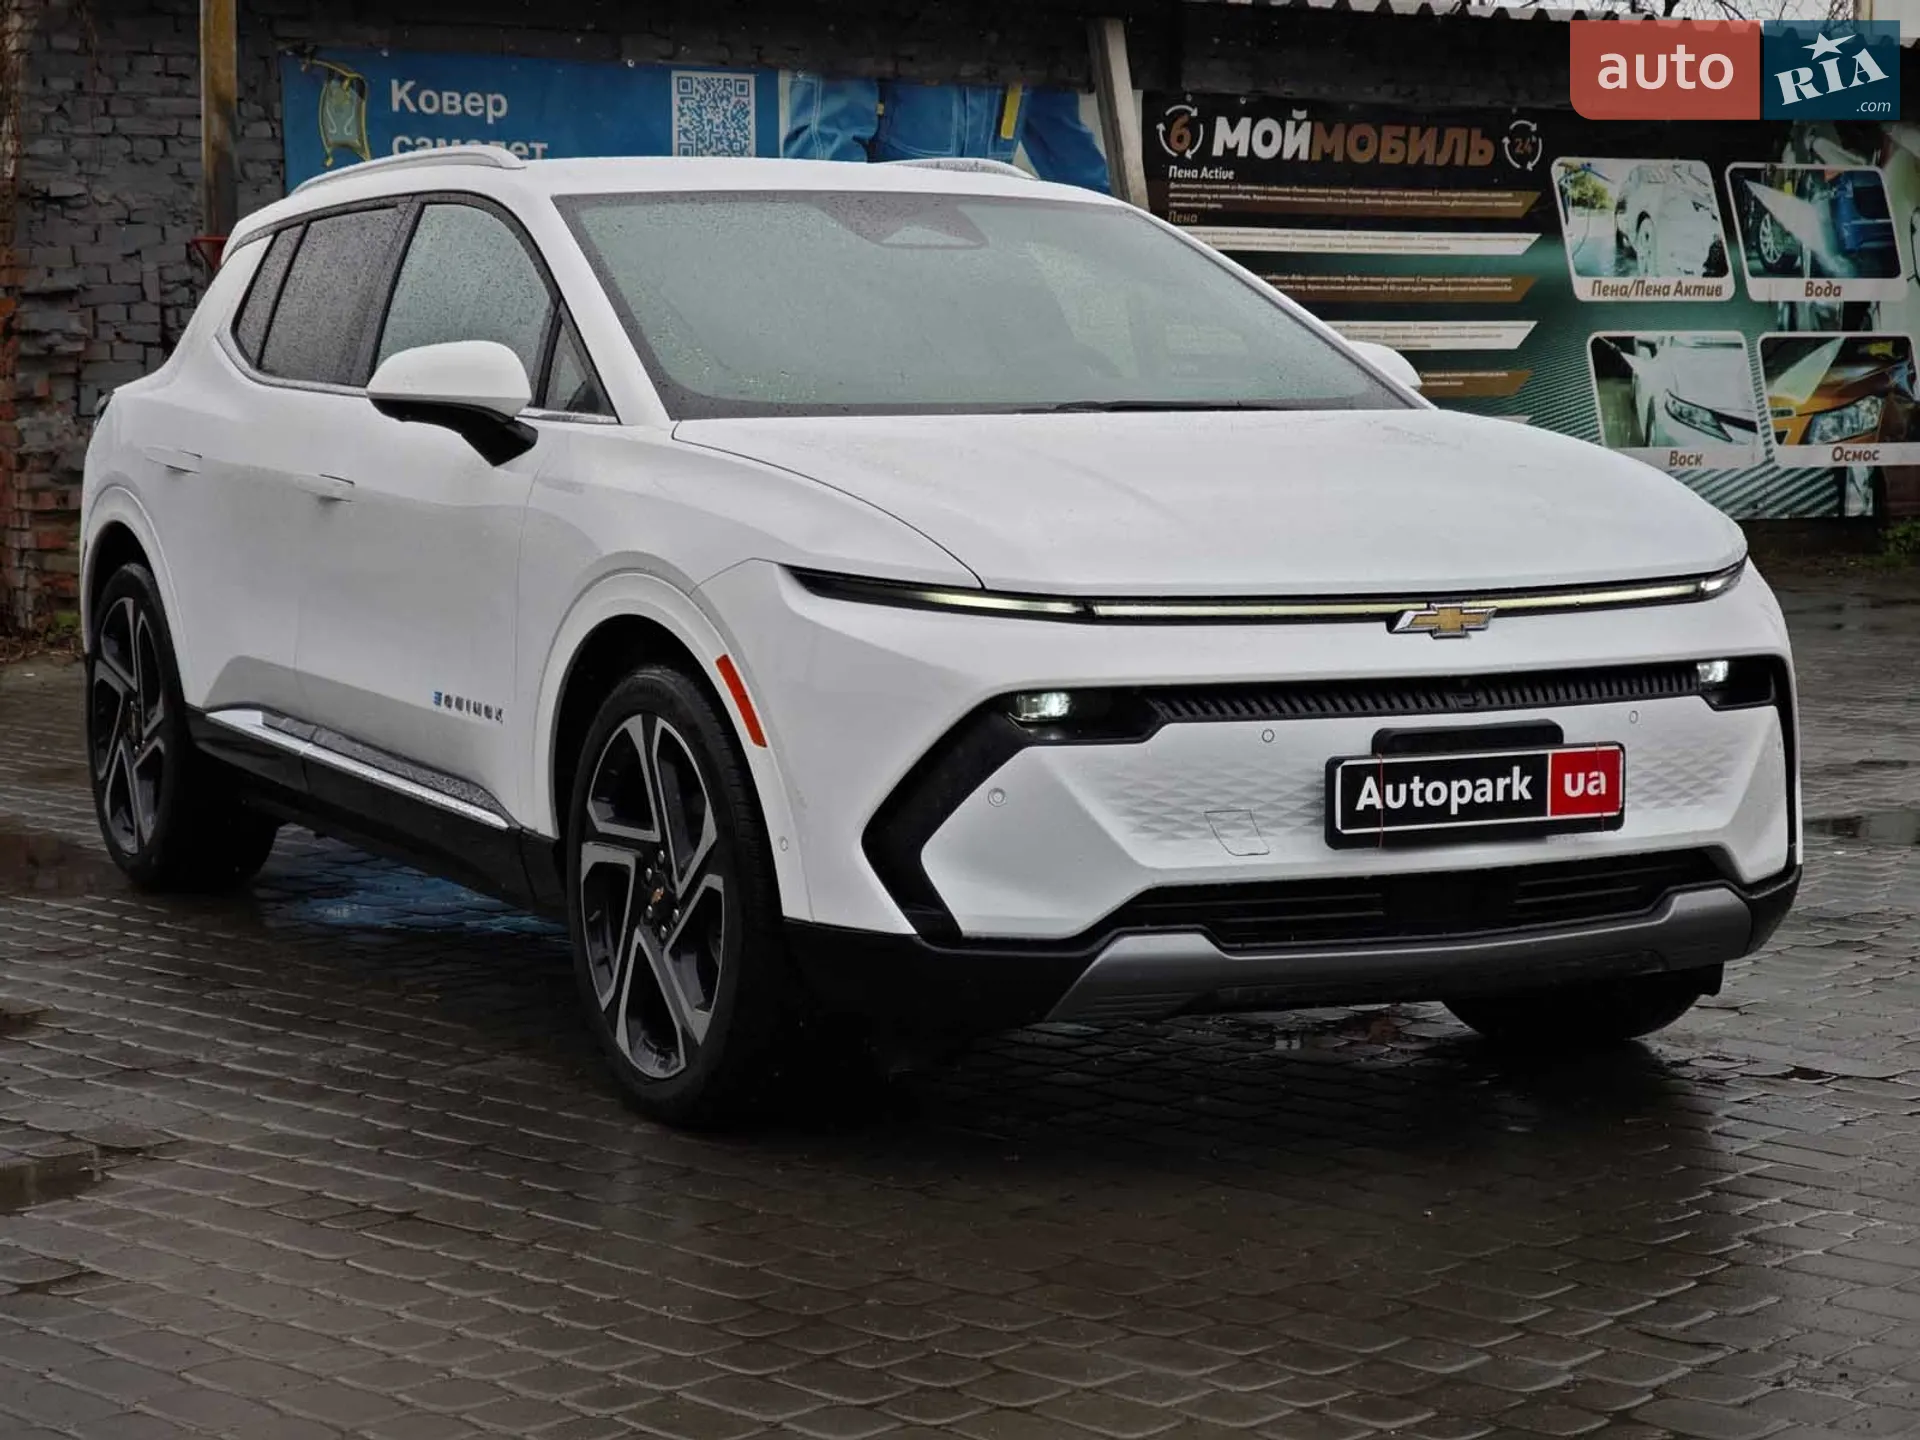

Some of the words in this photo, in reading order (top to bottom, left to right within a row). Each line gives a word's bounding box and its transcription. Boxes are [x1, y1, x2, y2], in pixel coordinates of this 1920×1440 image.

[390, 78, 508, 125] Ковер
[1169, 113, 1192, 153] 6
[1212, 109, 1495, 165] МОЙМОБИЛЬ
[1168, 165, 1198, 179] Пена
[1199, 165, 1235, 180] Active
[1168, 210, 1198, 223] Пена
[1591, 279, 1670, 298] Пена/Пена
[1673, 281, 1723, 298] Актив
[1804, 281, 1842, 298] Вода
[1668, 450, 1704, 467] Воск
[1832, 446, 1881, 462] Осмос
[1354, 765, 1533, 816] Autopark
[1563, 770, 1607, 798] ua
